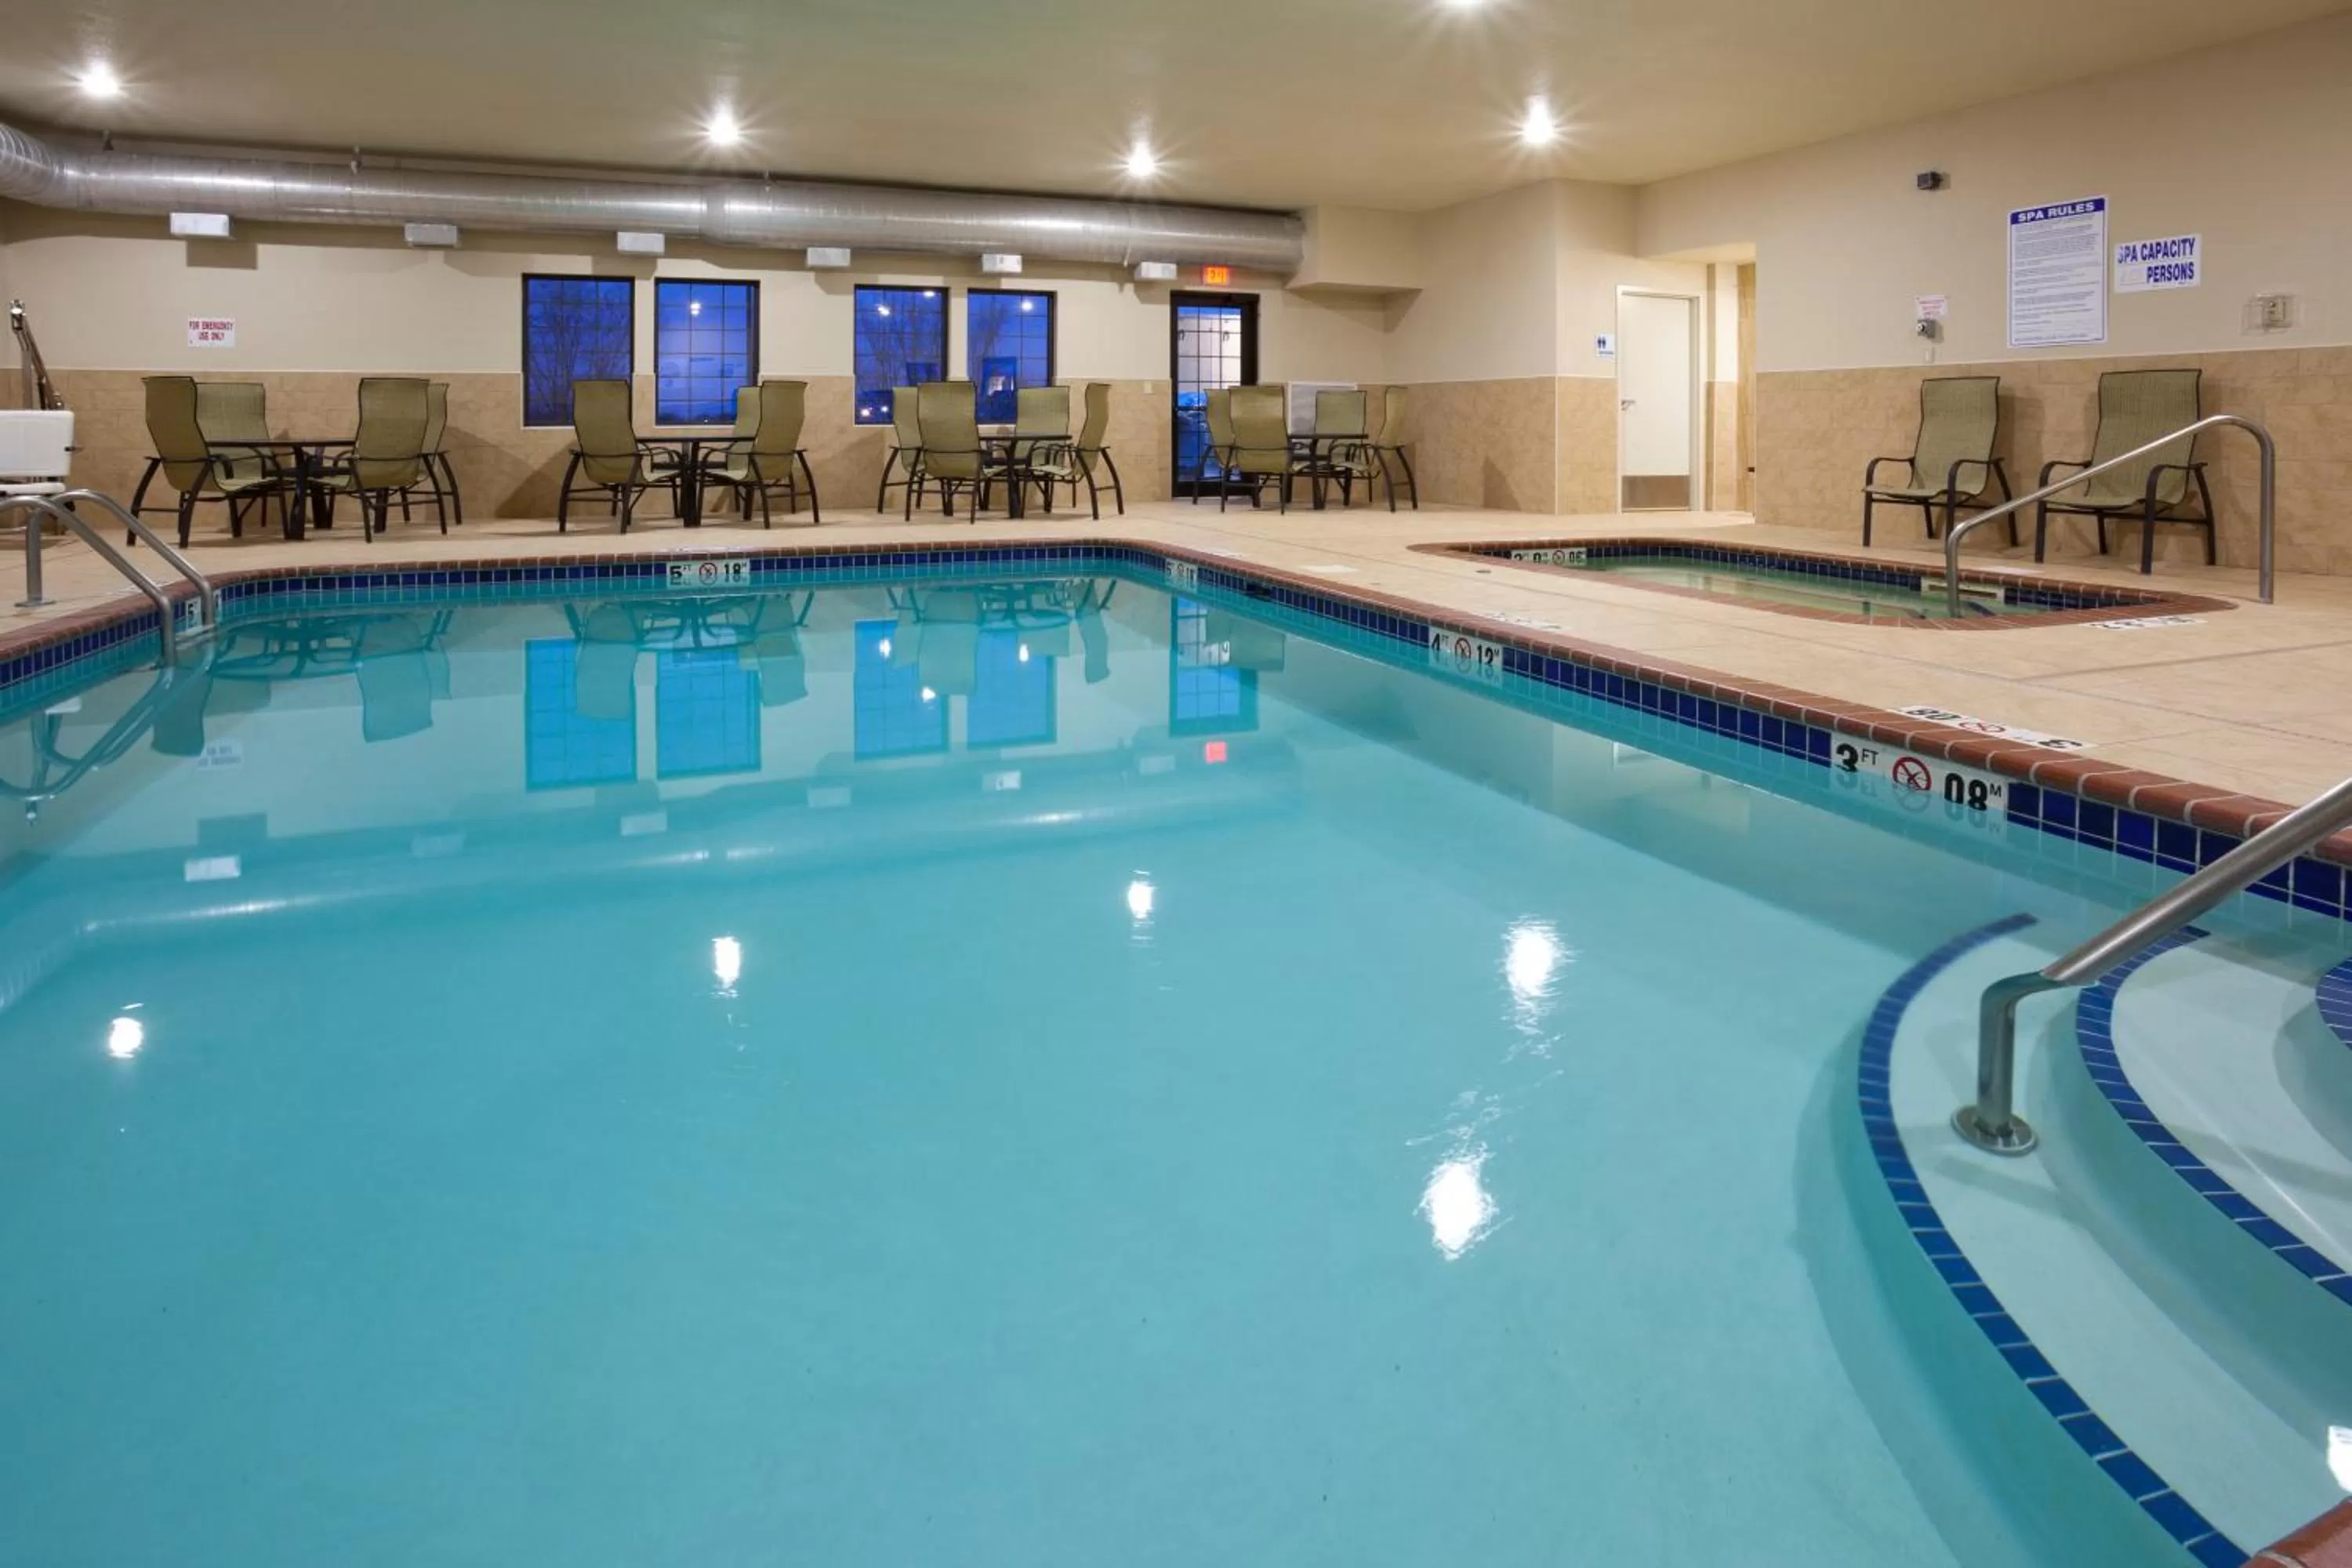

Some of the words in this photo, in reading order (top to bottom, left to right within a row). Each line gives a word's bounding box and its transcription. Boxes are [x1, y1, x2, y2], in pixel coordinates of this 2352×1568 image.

[2018, 209, 2044, 223] SPA
[2048, 201, 2095, 218] RULES
[2140, 237, 2195, 261] CAPACITY
[2147, 262, 2194, 284] PERSONS
